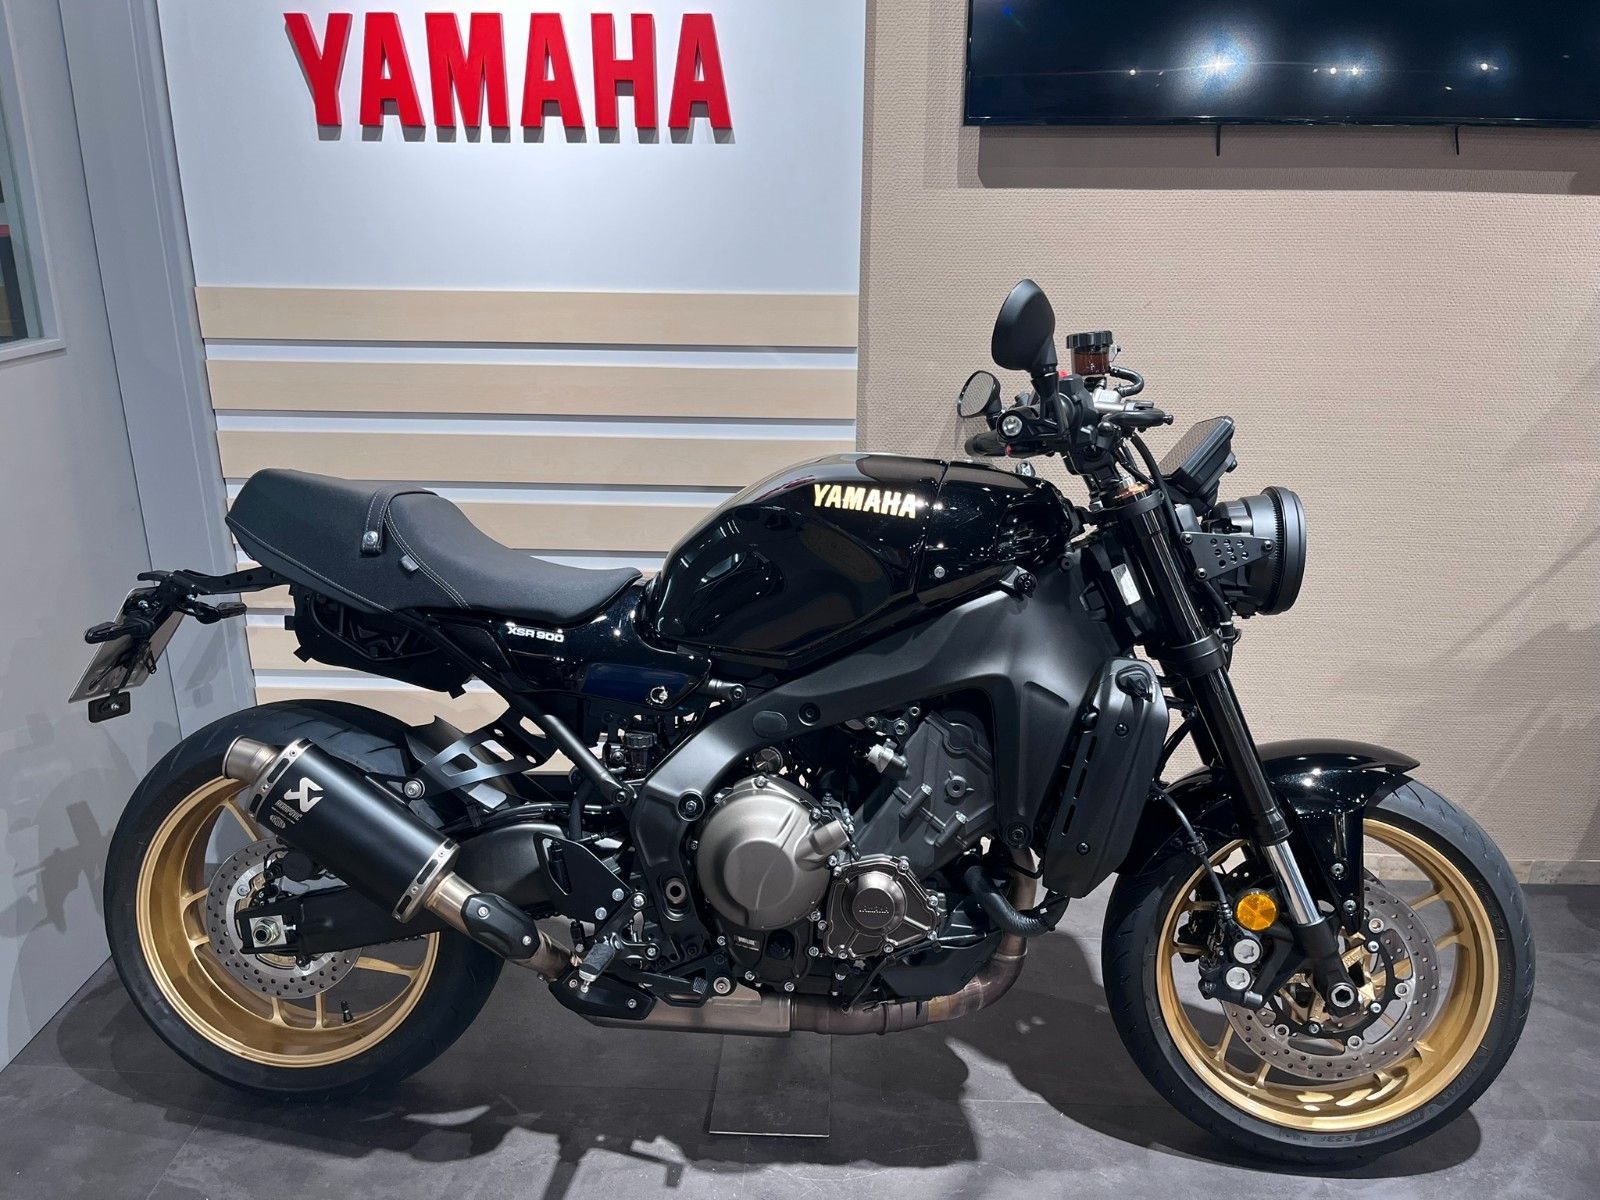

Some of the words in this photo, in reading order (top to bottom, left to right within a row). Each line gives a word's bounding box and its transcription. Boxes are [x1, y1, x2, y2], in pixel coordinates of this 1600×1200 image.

[283, 12, 733, 128] YAMAHA
[814, 484, 916, 519] YAMAHA
[507, 626, 535, 638] XSR
[536, 630, 564, 642] 900
